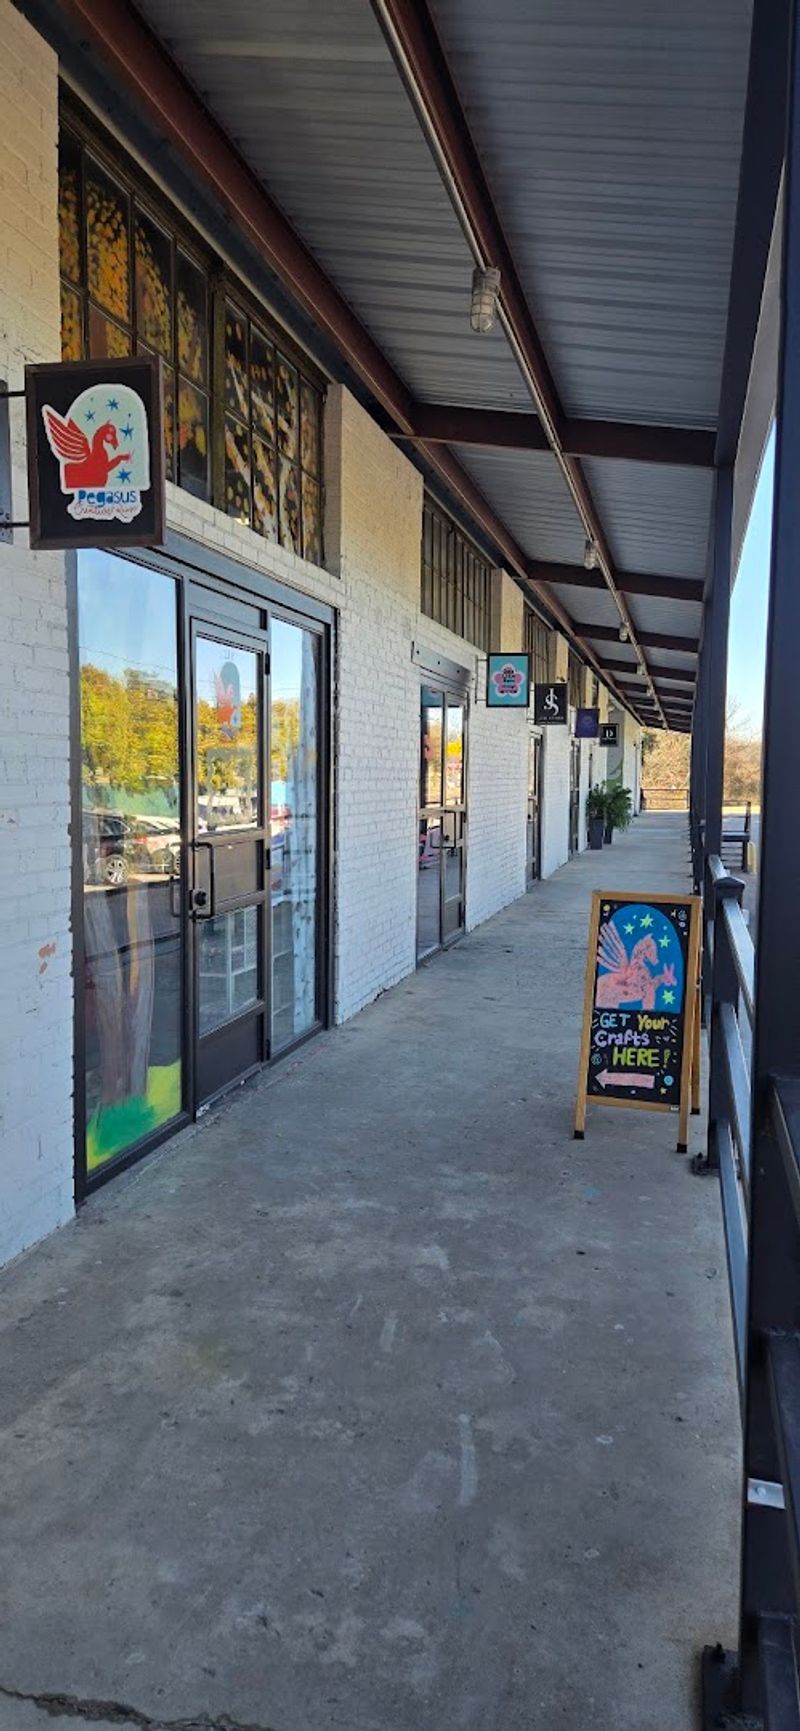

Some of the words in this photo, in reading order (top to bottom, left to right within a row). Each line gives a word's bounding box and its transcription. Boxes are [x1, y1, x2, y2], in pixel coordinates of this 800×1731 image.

[78, 490, 136, 508] Pegasus
[600, 1012, 631, 1028] GET
[637, 1014, 670, 1031] Your
[594, 1029, 650, 1047] Crafts
